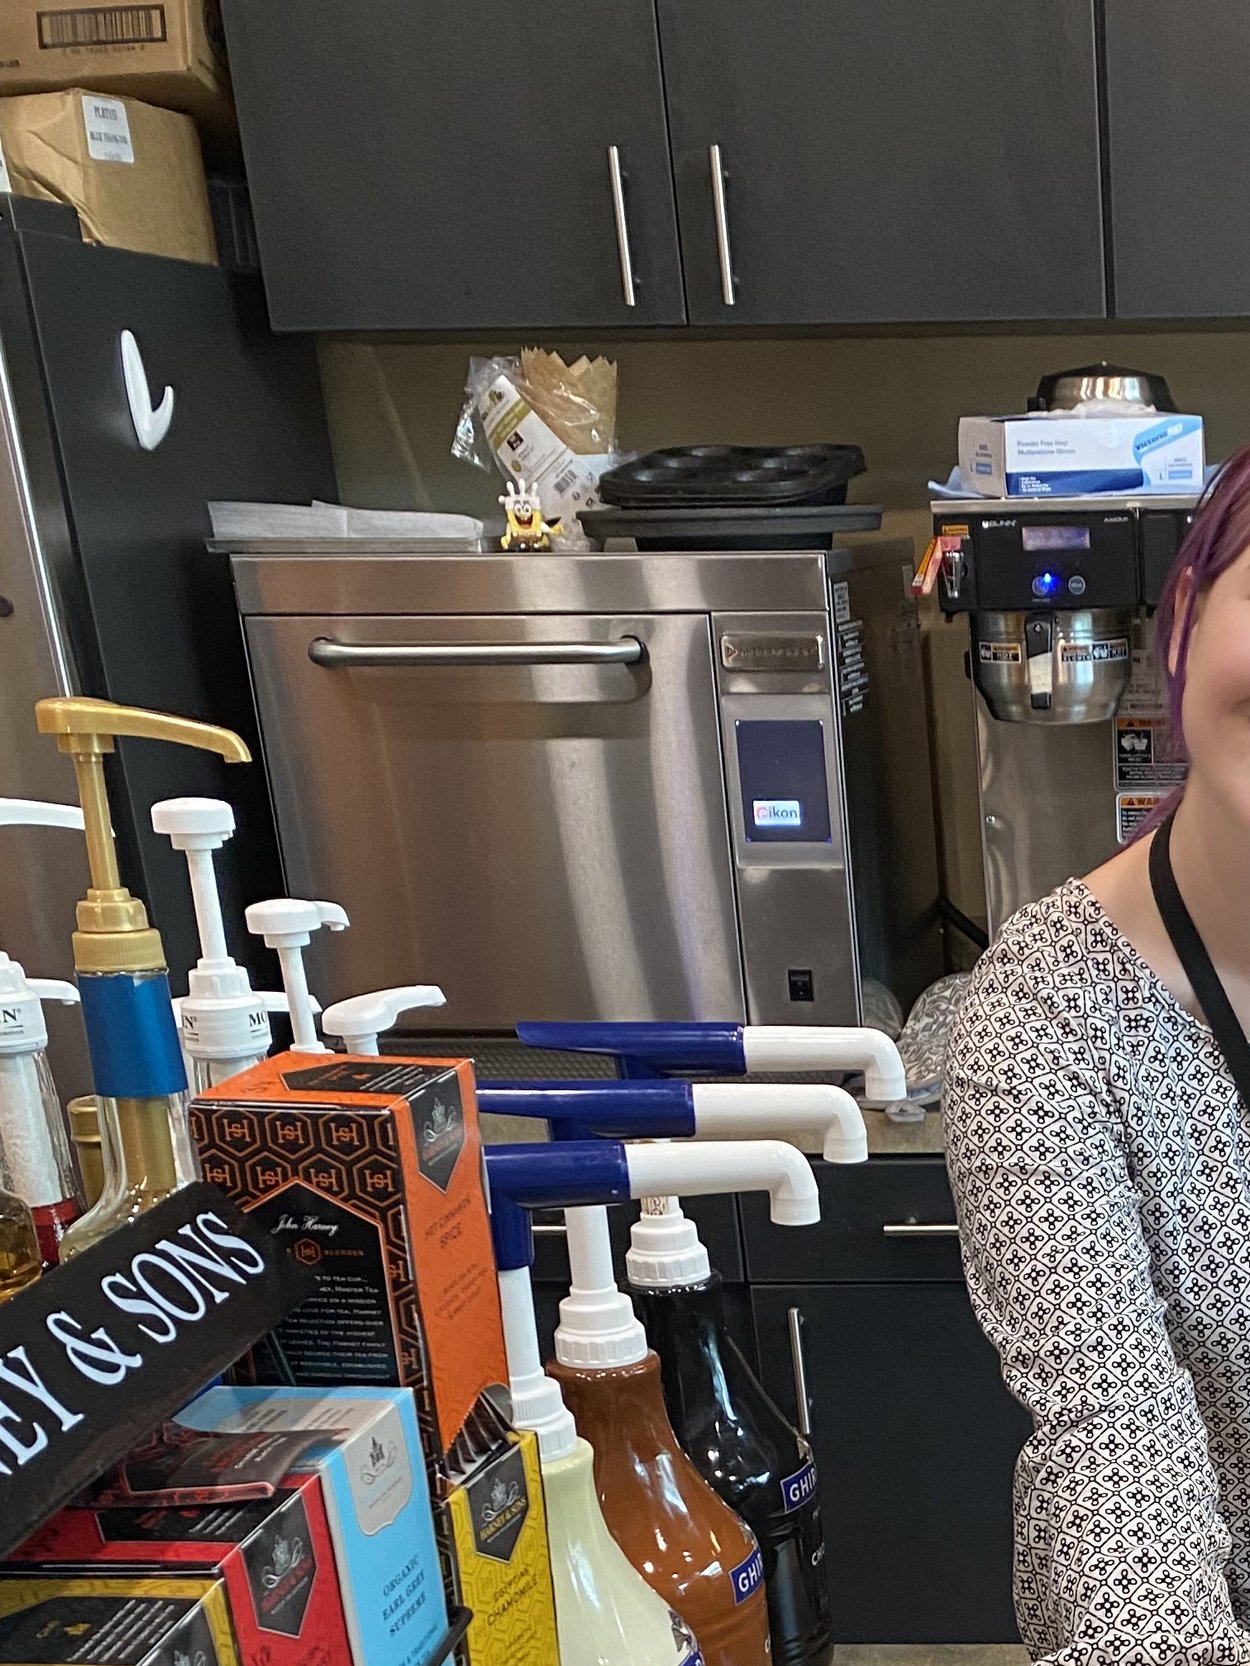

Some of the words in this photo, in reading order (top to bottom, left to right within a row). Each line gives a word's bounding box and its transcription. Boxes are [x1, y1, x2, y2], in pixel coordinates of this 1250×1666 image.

[270, 1214, 299, 1234] John
[0, 1346, 84, 1475] EY
[46, 1310, 143, 1386] &
[101, 1211, 265, 1343] SONS
